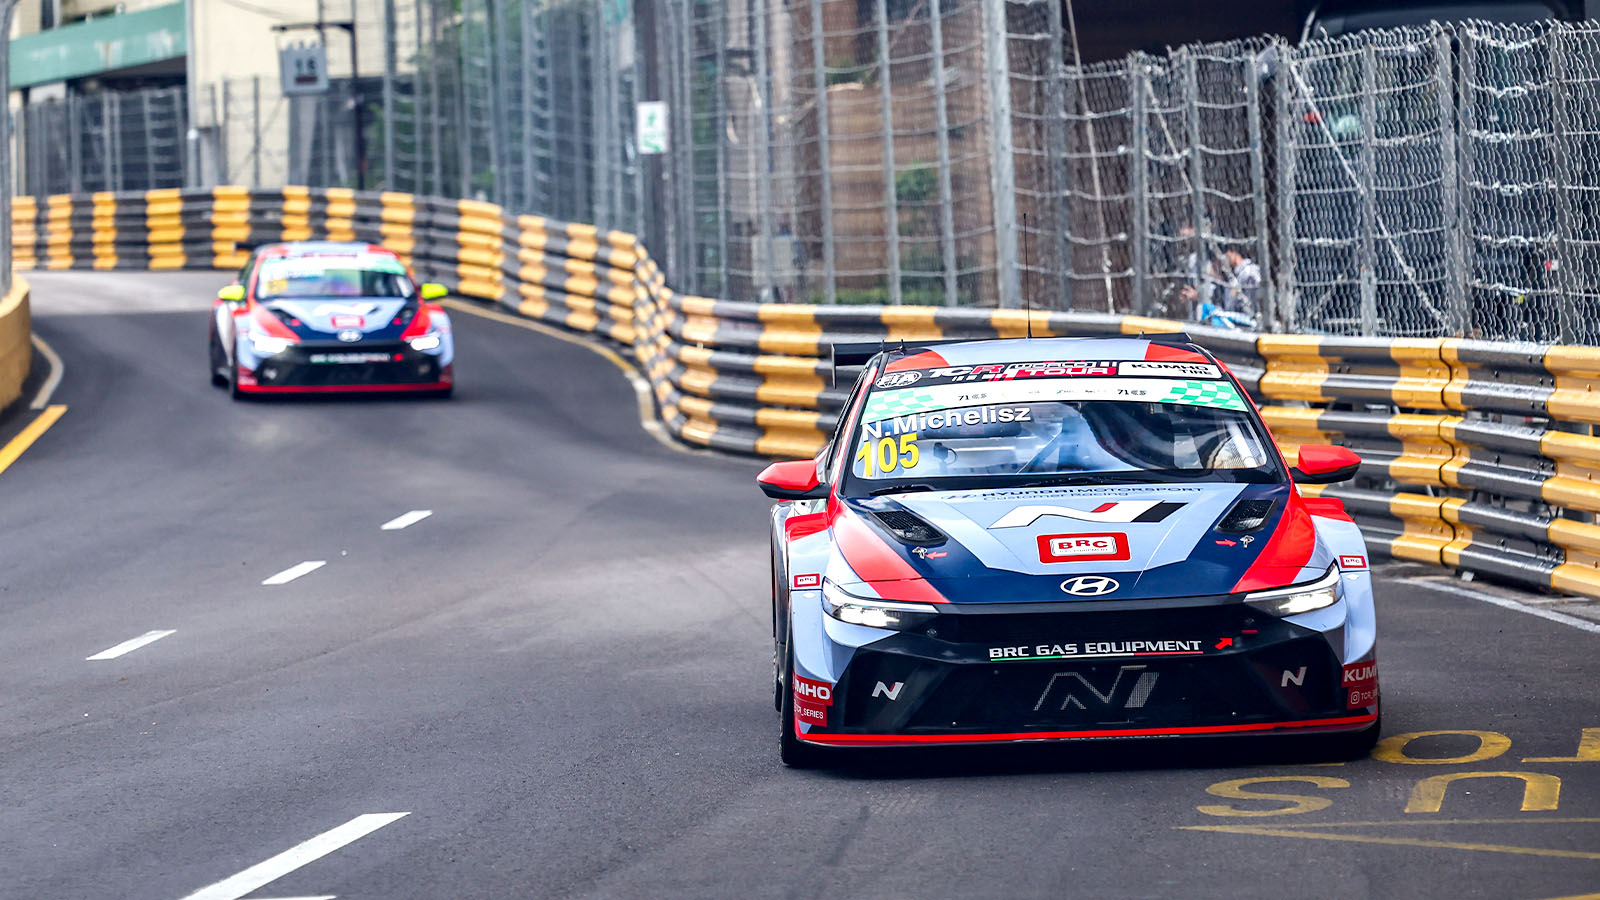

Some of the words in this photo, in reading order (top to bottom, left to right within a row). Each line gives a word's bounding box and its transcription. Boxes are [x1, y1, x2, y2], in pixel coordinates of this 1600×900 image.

[929, 364, 1006, 379] TCR
[1013, 361, 1098, 369] WORLD
[1025, 367, 1109, 376] TOUR
[879, 371, 916, 388] FIA
[862, 405, 1031, 441] N.Michelisz
[857, 433, 920, 477] 105
[1058, 539, 1108, 549] BRC
[989, 646, 1030, 658] BRC
[1036, 643, 1078, 656] GAS
[1085, 640, 1202, 653] EQUIPMENT
[1281, 666, 1308, 687] N
[1344, 664, 1377, 682] KUM
[793, 675, 831, 700] MHO
[872, 680, 904, 700] N
[1197, 771, 1561, 817] US
